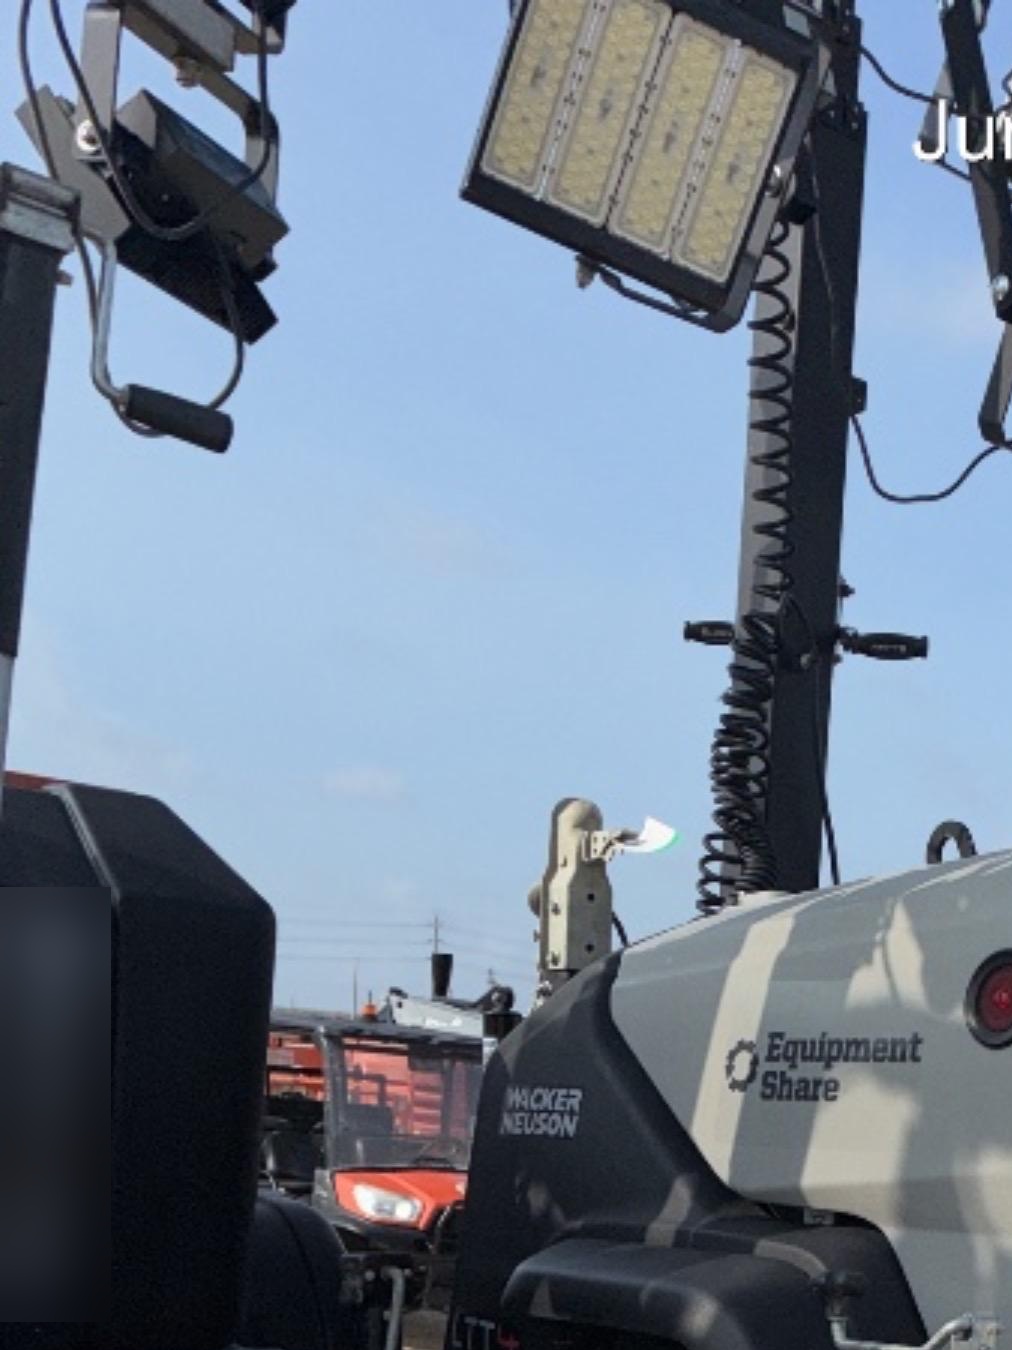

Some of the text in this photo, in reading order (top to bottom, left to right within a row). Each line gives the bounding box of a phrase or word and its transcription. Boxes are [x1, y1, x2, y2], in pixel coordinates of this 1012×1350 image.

[765, 1031, 923, 1070] Equipment
[506, 1087, 583, 1112] WACKER
[760, 1071, 840, 1101] Share
[500, 1111, 579, 1138] NEUSON
